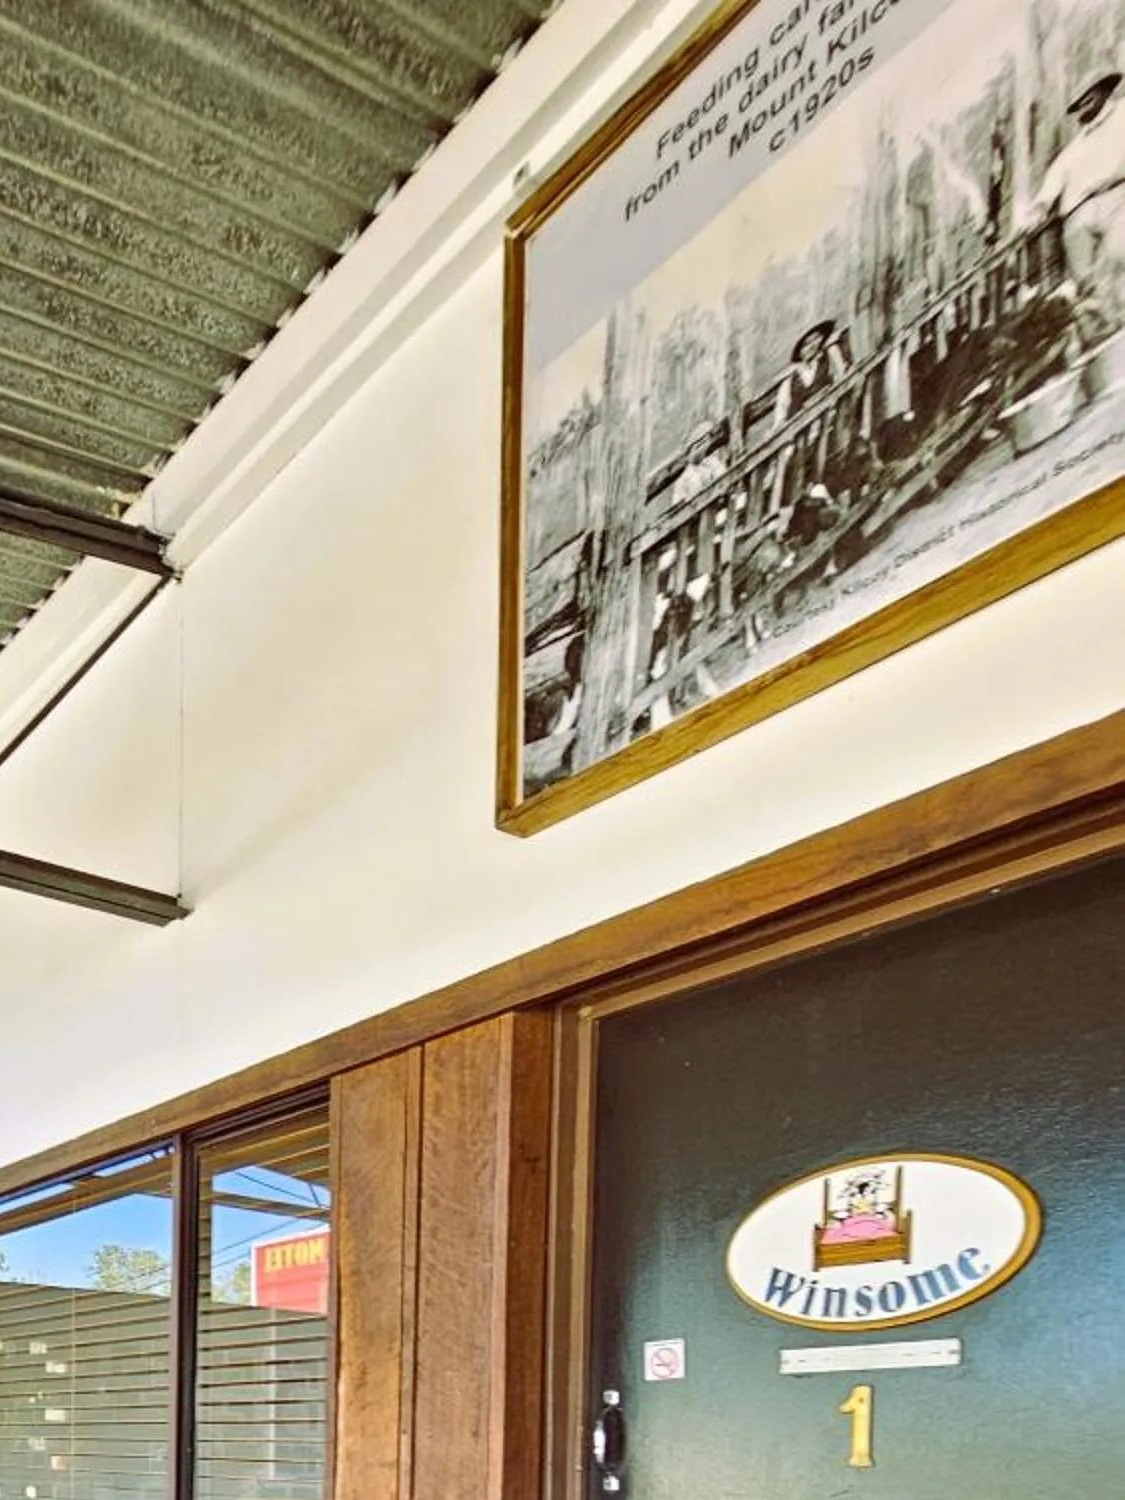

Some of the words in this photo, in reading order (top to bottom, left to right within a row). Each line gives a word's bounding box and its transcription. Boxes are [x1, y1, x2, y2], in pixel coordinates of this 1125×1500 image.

[625, 160, 680, 222] from
[688, 113, 729, 160] the
[738, 32, 809, 113] dairy
[656, 45, 760, 160] Feeding
[729, 59, 817, 160] Mount
[827, 0, 899, 66] Kilc
[769, 46, 874, 152] c1920s
[838, 1384, 874, 1468] 1
